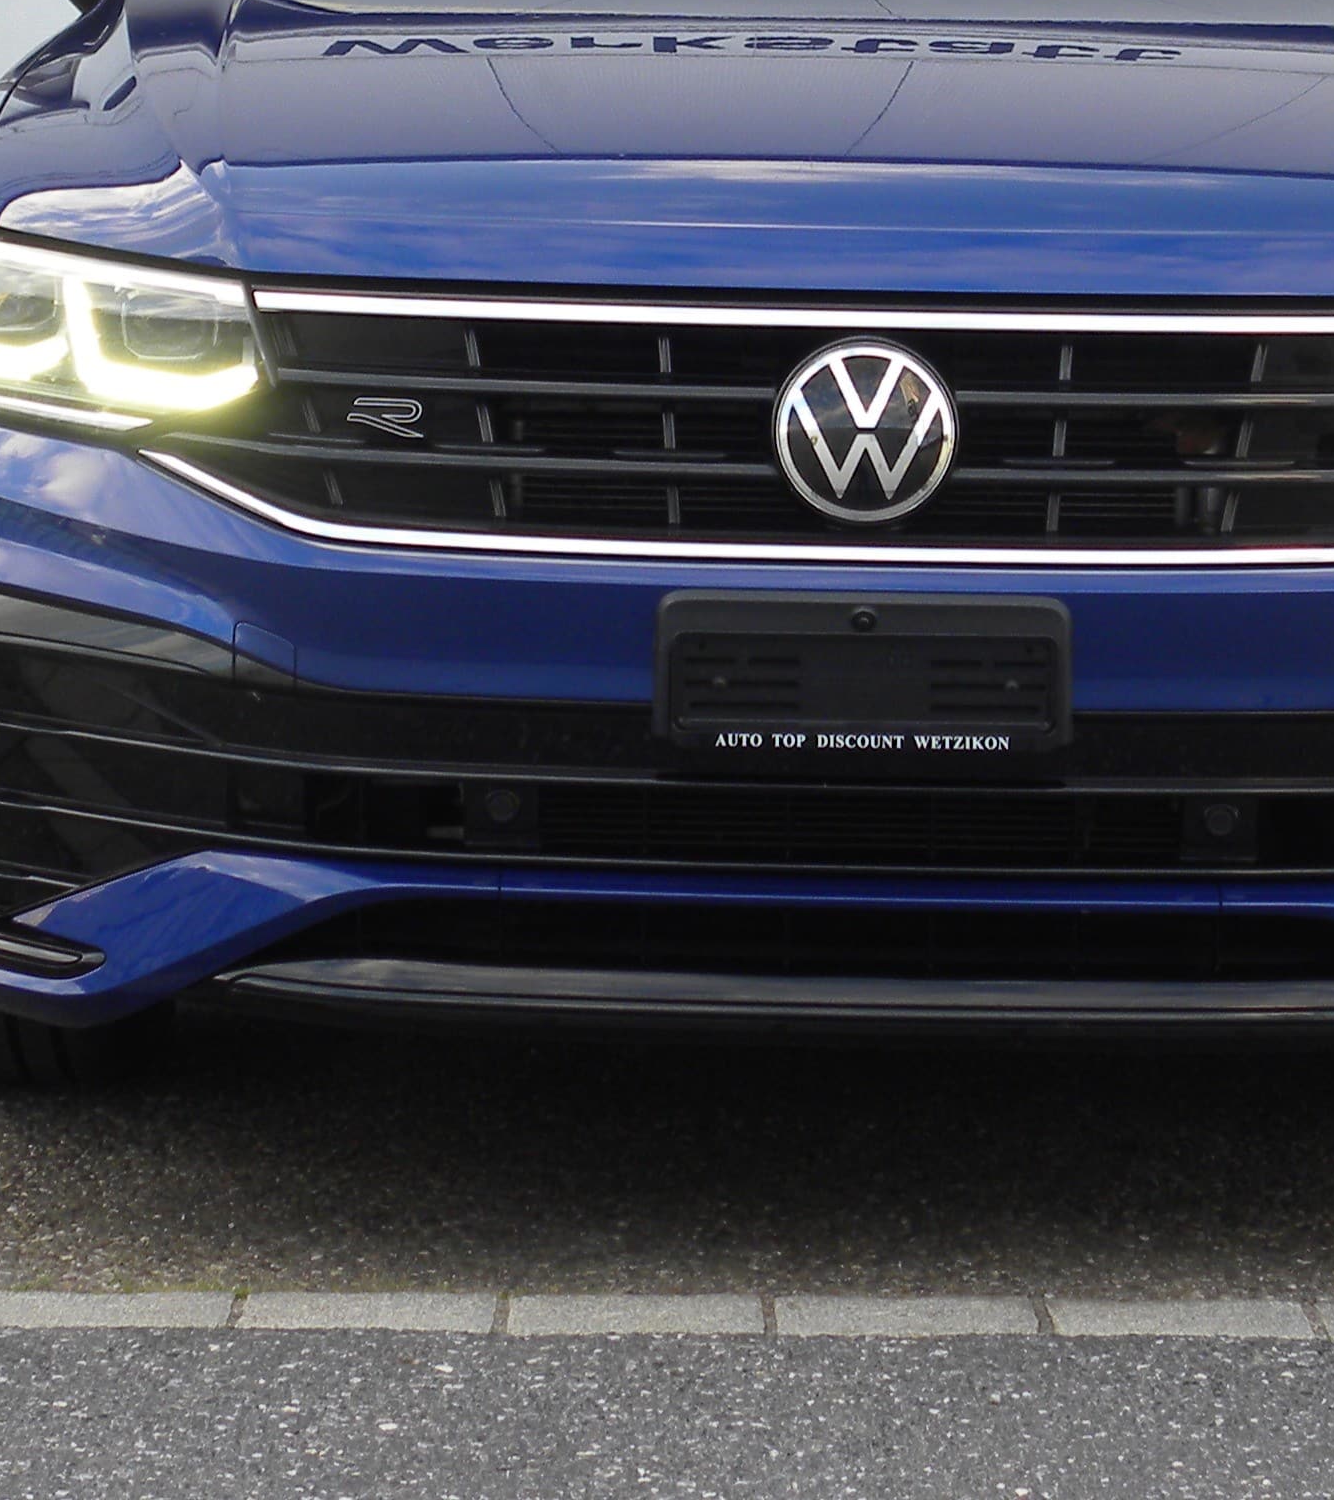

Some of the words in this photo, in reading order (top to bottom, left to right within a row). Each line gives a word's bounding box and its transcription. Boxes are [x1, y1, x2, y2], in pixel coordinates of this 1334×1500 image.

[346, 396, 424, 439] R
[715, 732, 763, 748] AUTO
[772, 733, 807, 748] TOP
[817, 733, 905, 749] DISCOUNT
[914, 735, 1011, 751] WETZIKON
